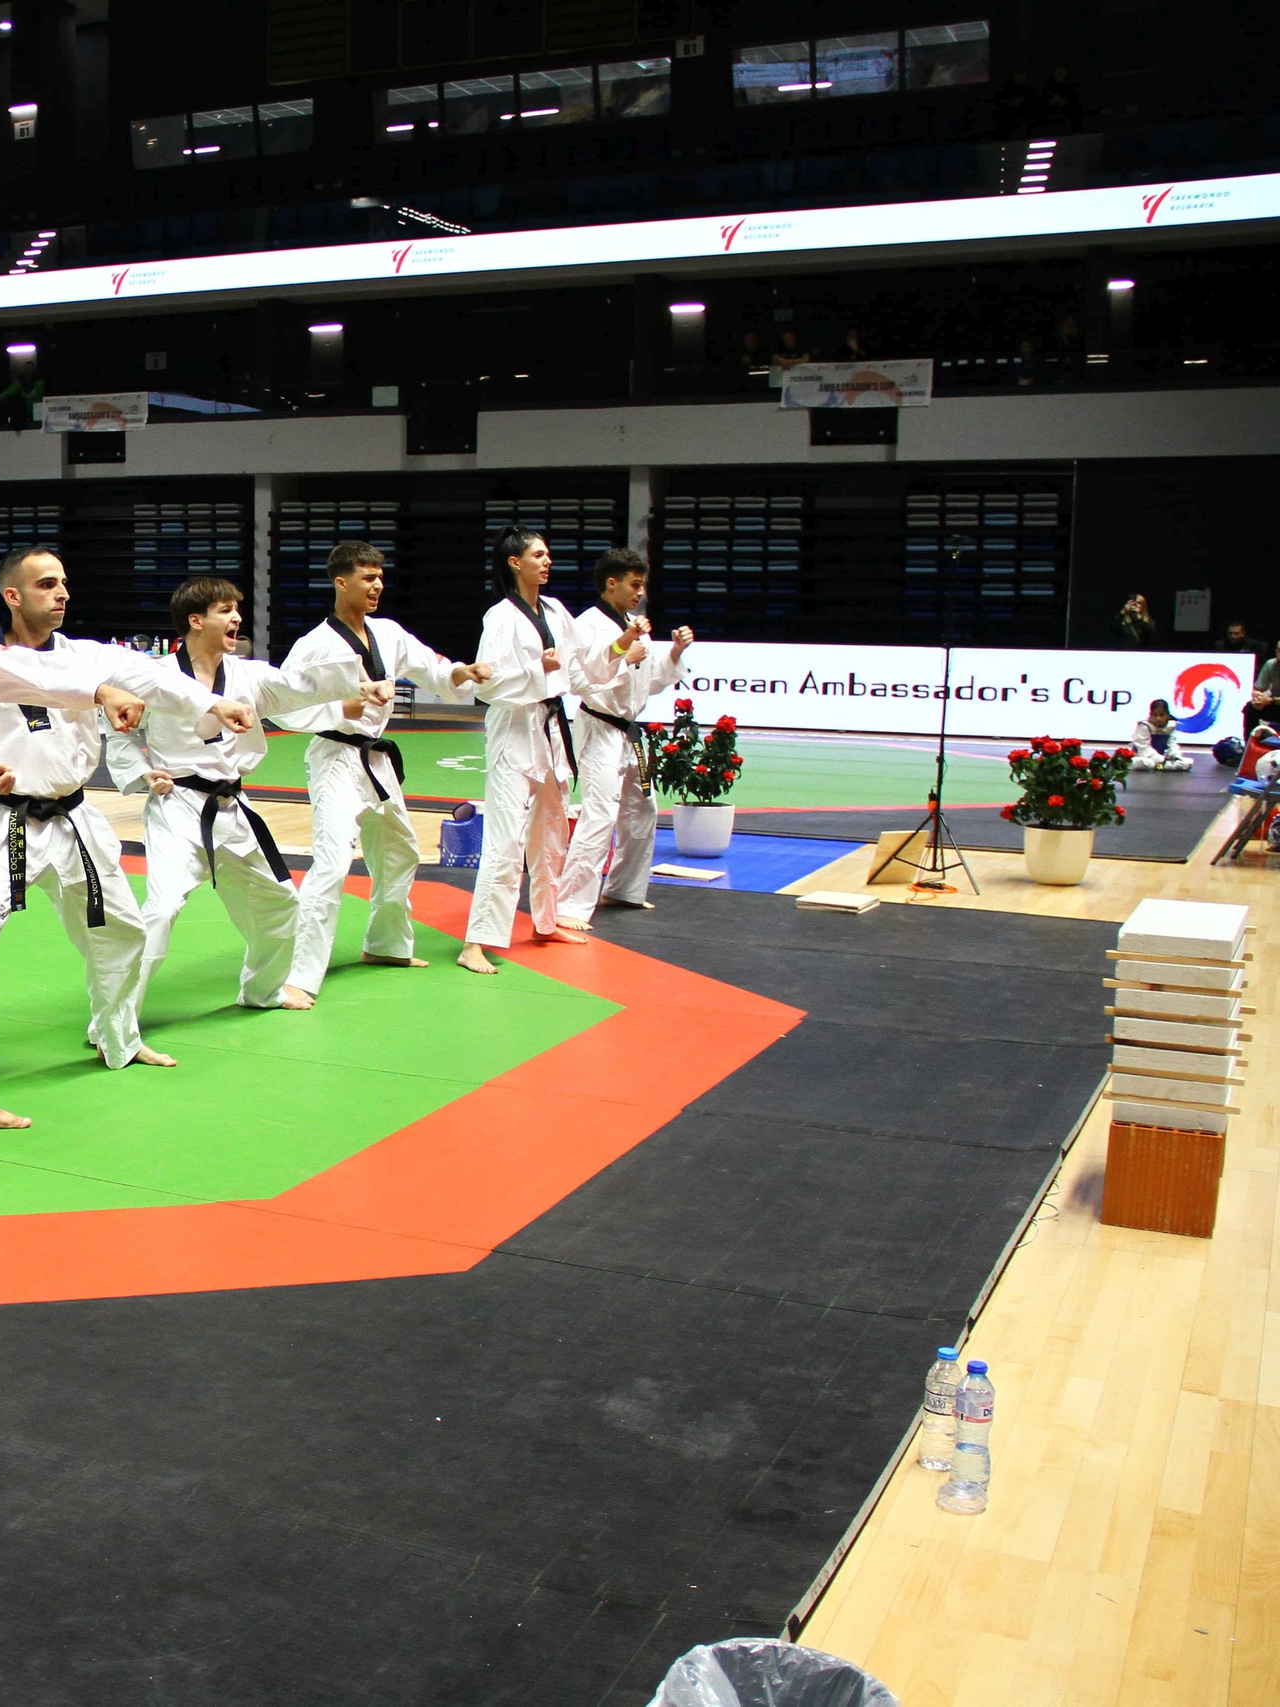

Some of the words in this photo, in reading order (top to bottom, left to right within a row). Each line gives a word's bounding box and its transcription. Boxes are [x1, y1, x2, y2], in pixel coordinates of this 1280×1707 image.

[1171, 190, 1230, 200] TAEKWONDO
[799, 670, 1050, 703] Ambassador's
[1063, 678, 1132, 712] Cup
[9, 811, 19, 871] TAEKWON-DO
